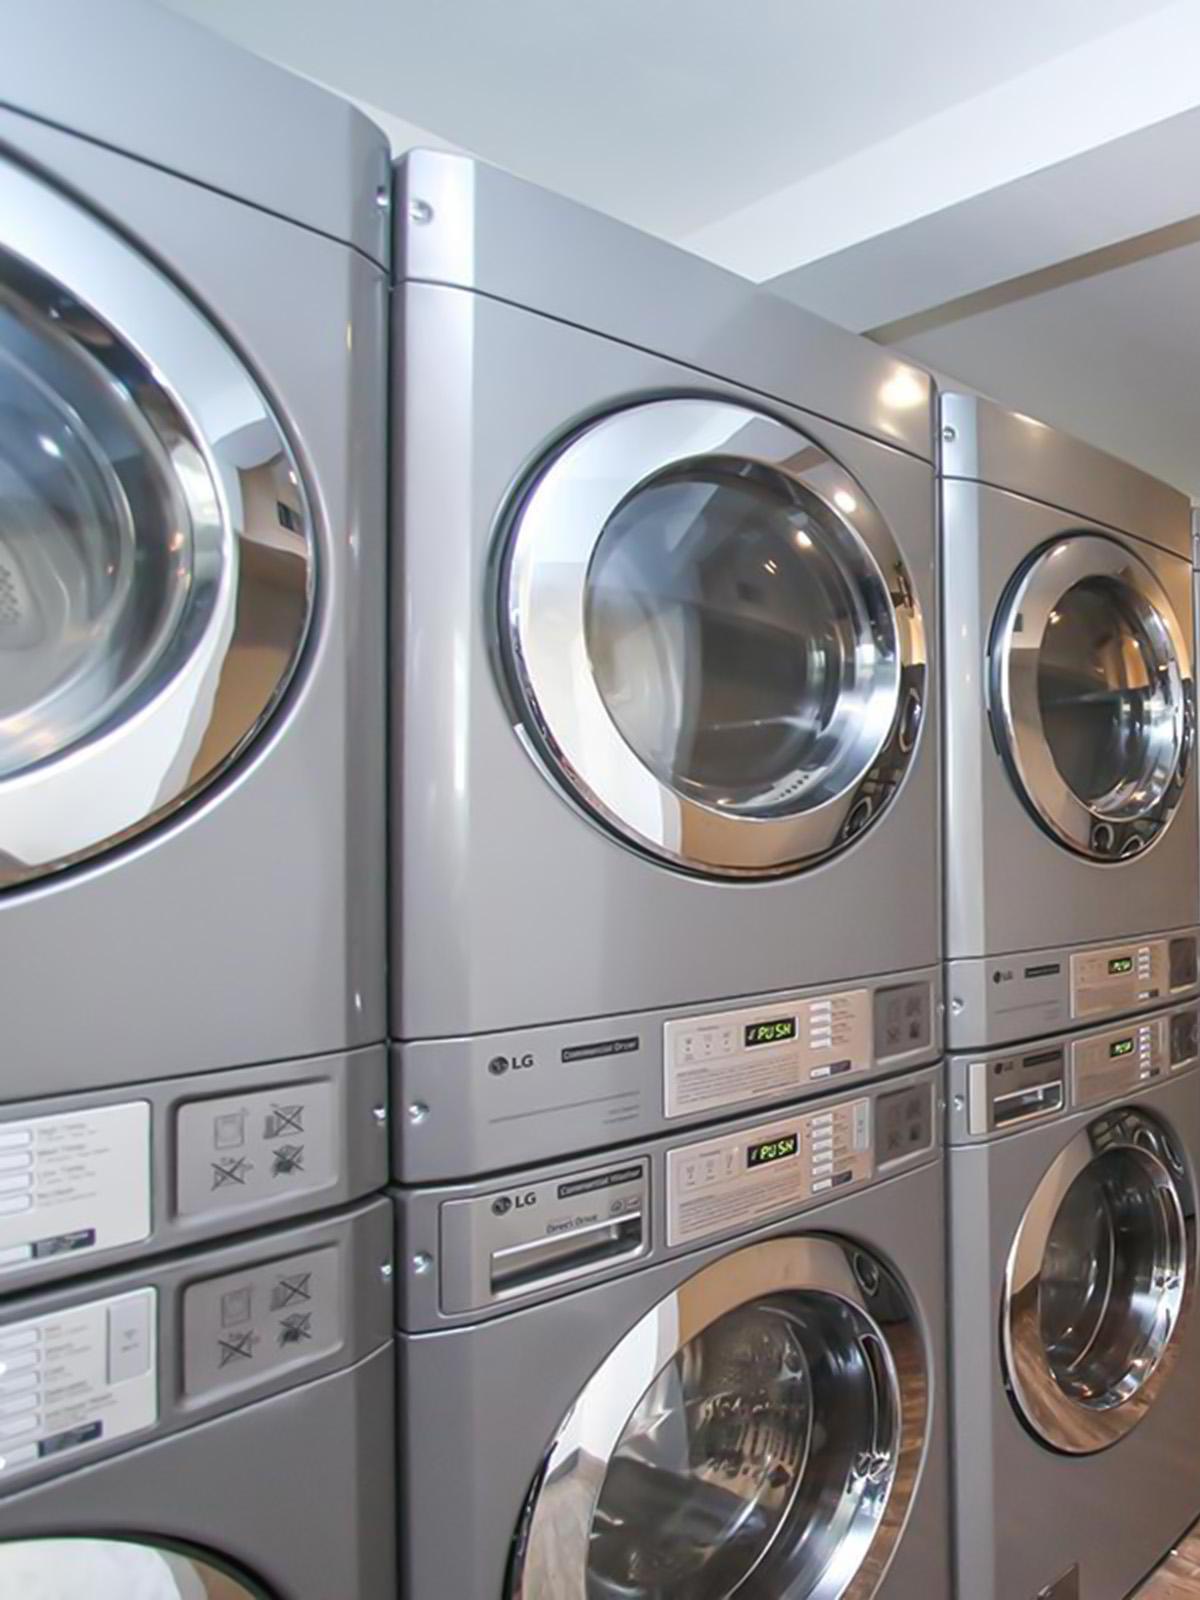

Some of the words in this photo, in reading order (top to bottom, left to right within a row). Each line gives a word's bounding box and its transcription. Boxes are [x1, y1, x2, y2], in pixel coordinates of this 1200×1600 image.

[757, 1023, 792, 1040] PUSH
[512, 1054, 534, 1070] LG
[760, 1139, 795, 1160] PUSH
[515, 1192, 537, 1208] LG
